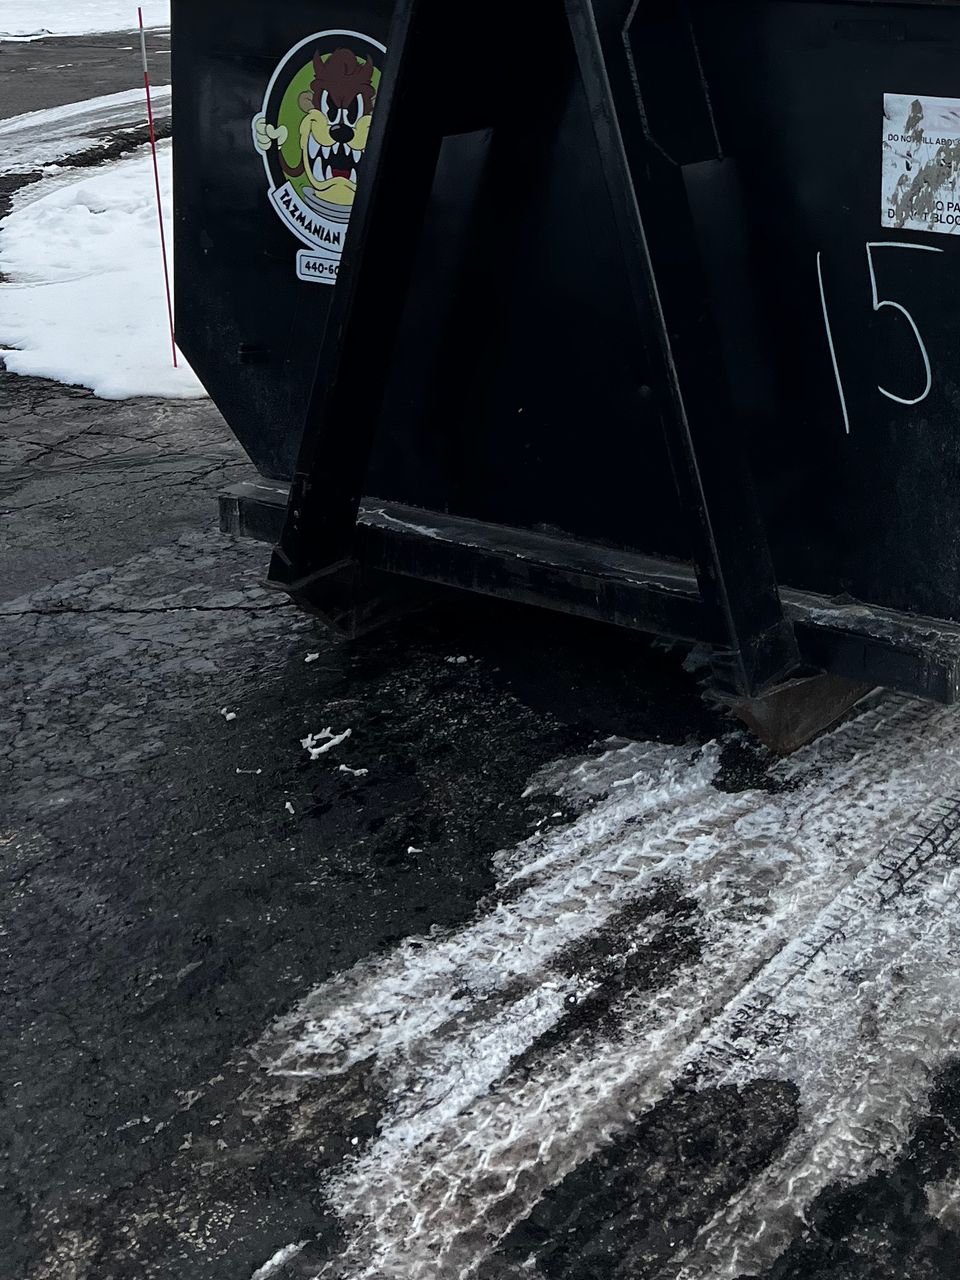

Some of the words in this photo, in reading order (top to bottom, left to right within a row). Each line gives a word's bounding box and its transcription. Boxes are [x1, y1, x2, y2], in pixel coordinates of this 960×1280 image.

[888, 133, 899, 142] DO
[901, 135, 914, 143] NO
[920, 137, 934, 145] ILL
[279, 188, 341, 246] TAZMANIAN
[816, 241, 944, 435] 15
